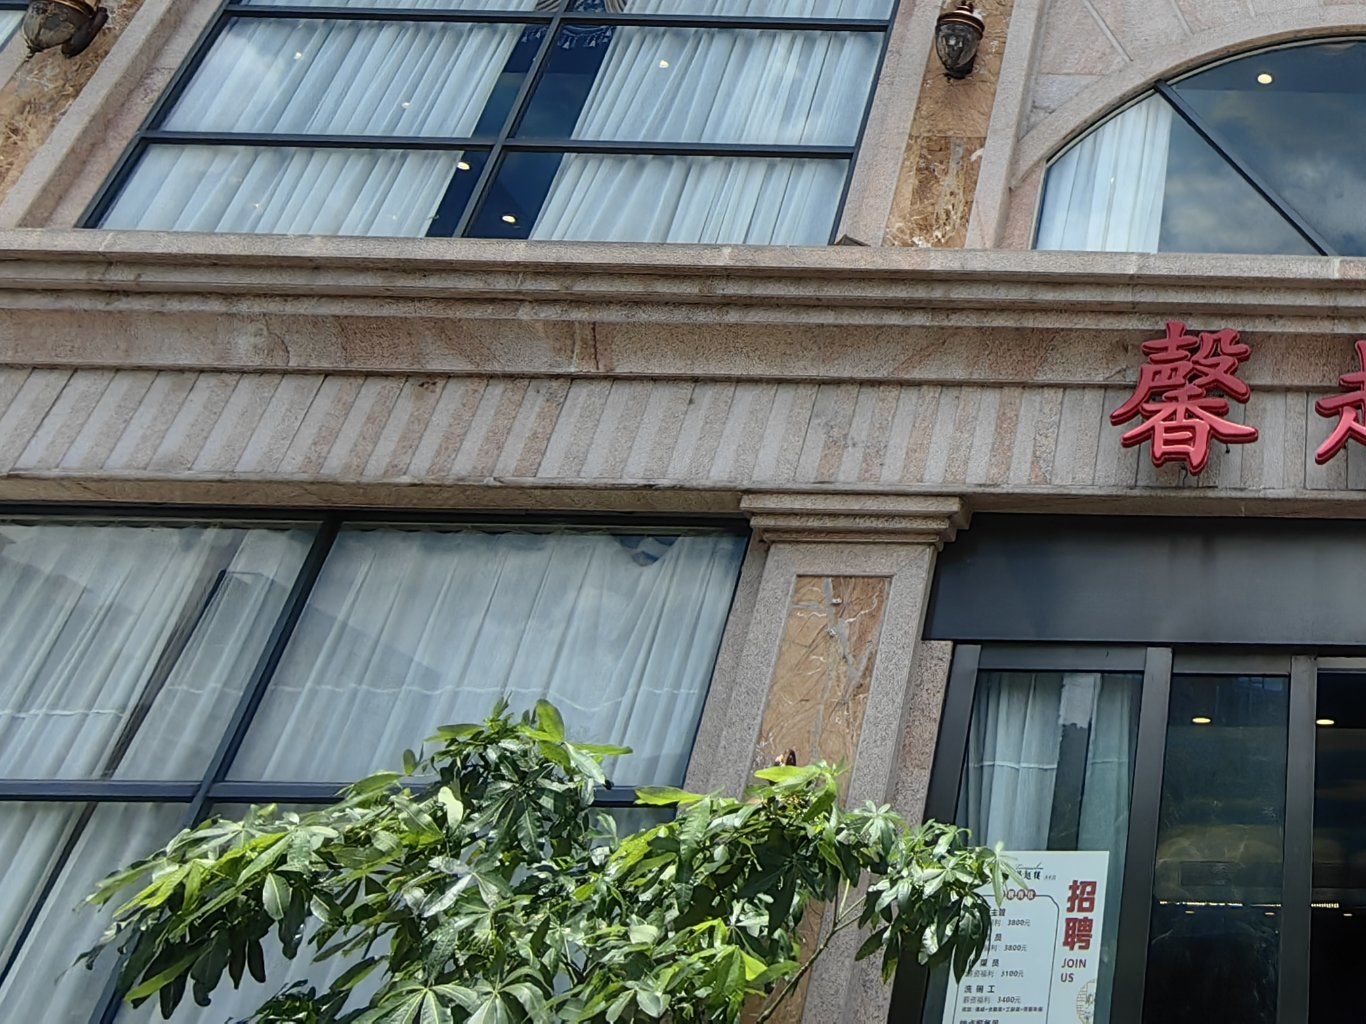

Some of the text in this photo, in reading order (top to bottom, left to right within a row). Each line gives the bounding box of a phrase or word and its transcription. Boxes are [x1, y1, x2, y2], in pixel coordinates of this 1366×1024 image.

[1062, 880, 1097, 951] 招聘
[1061, 958, 1087, 968] JOIN
[1060, 973, 1074, 982] US
